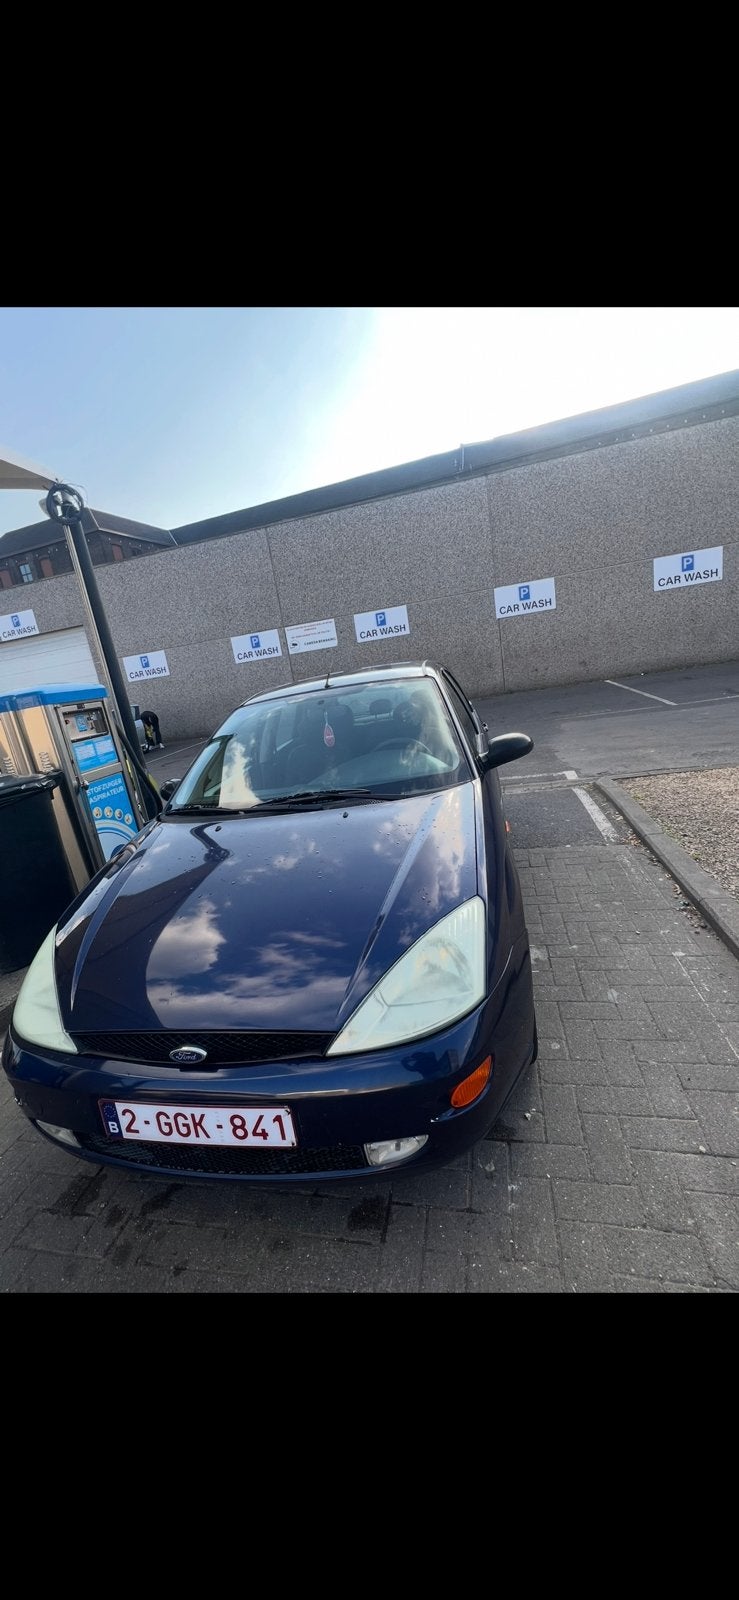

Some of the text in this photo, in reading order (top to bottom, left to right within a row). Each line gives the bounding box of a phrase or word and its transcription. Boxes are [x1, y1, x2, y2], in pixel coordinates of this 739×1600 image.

[683, 557, 693, 569] P
[658, 568, 719, 587] CAR WASH
[520, 587, 529, 599] P
[499, 598, 552, 615] CAR WASH
[12, 616, 19, 626] P
[377, 614, 385, 625] P
[2, 625, 37, 639] CAR WASH
[359, 624, 406, 639] CAR WASH
[252, 637, 259, 647] P
[237, 647, 279, 661] CAR WASH
[141, 657, 149, 667] P
[129, 666, 167, 679] CAR WASH
[89, 785, 124, 804] ASPIRATEUR
[175, 1051, 196, 1061] Ford
[108, 1121, 119, 1134] B
